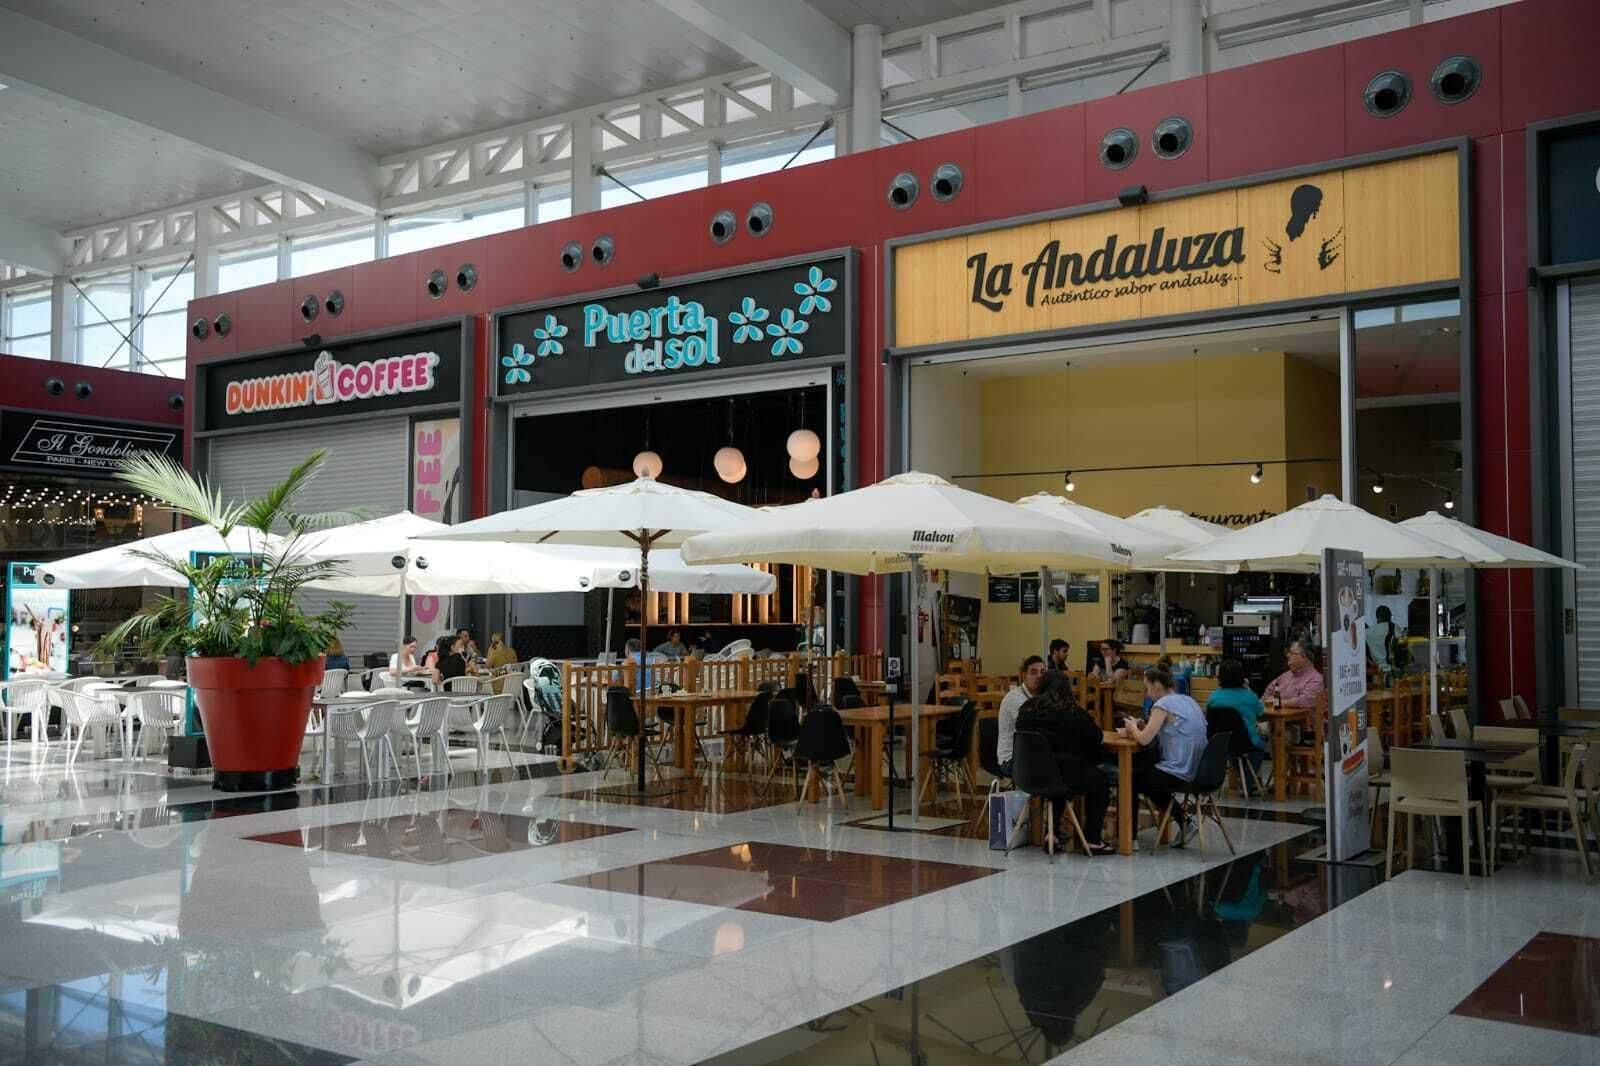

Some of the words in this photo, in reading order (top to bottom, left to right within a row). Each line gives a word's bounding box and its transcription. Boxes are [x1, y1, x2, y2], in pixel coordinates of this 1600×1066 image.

[966, 252, 1012, 312] La
[1021, 226, 1245, 308] Andaluza
[1041, 287, 1110, 306] Auténtico
[1114, 281, 1155, 298] sabor
[583, 295, 706, 347] Puerta
[624, 340, 664, 374] del
[664, 315, 720, 370] sol
[227, 372, 314, 414] DUNKIN'
[337, 355, 431, 399] COFFEE
[37, 433, 68, 451] Il
[46, 455, 76, 464] PARIS
[83, 459, 107, 467] NEW
[107, 460, 122, 468] YO
[912, 529, 955, 543] Mahou
